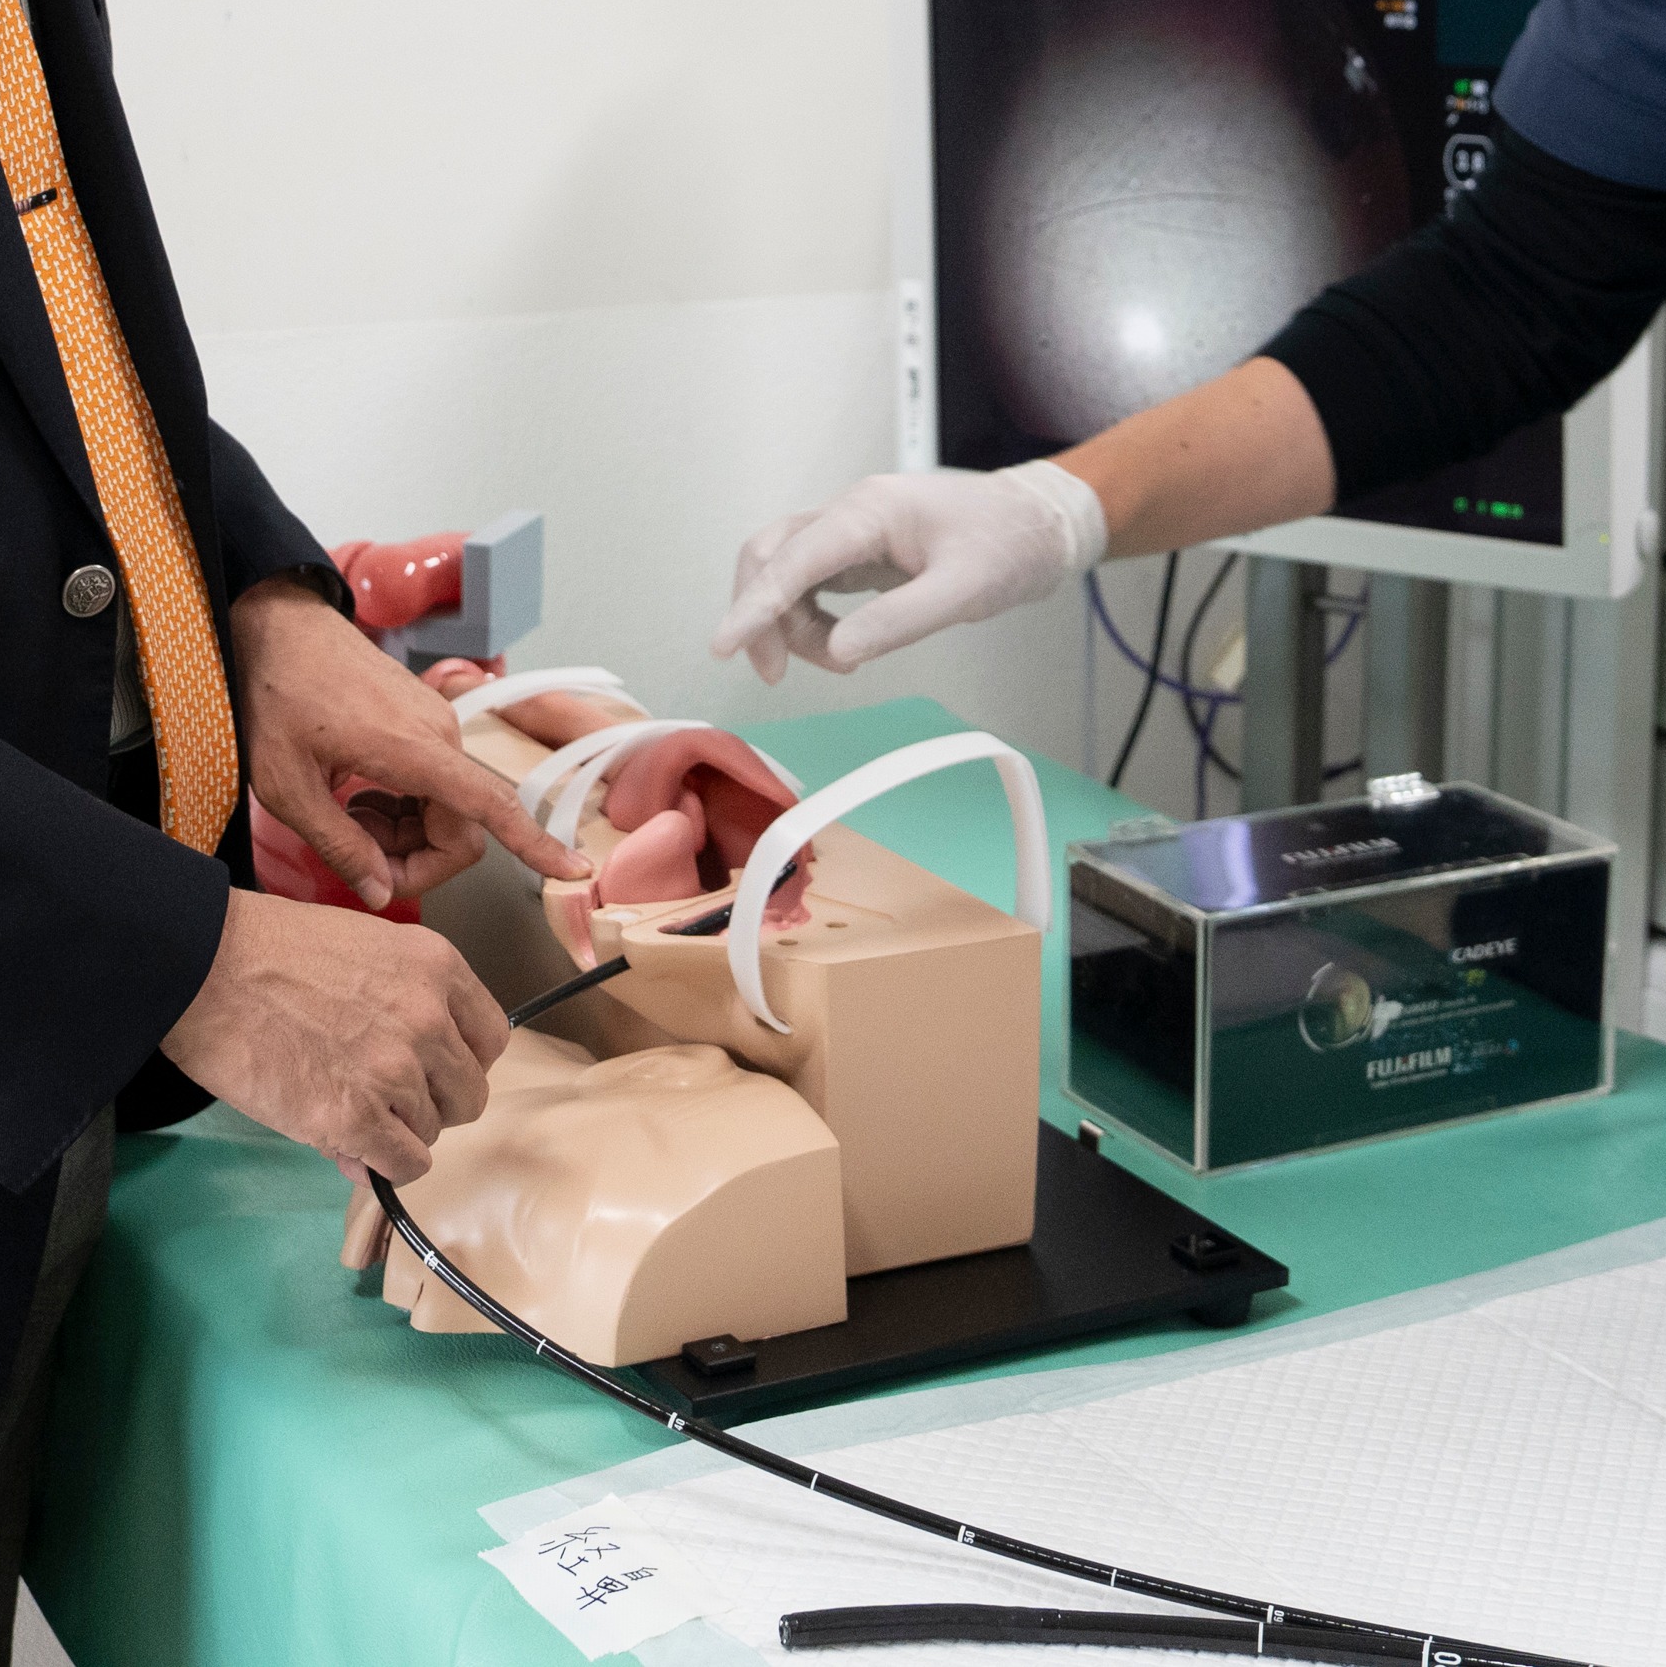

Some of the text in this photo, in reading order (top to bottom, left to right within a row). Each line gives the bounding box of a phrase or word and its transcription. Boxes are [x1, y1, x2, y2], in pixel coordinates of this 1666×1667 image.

[1367, 1046, 1452, 1080] FUJIFILM
[673, 1417, 686, 1431] 40
[963, 1530, 976, 1544] 50
[1273, 1609, 1285, 1623] 60
